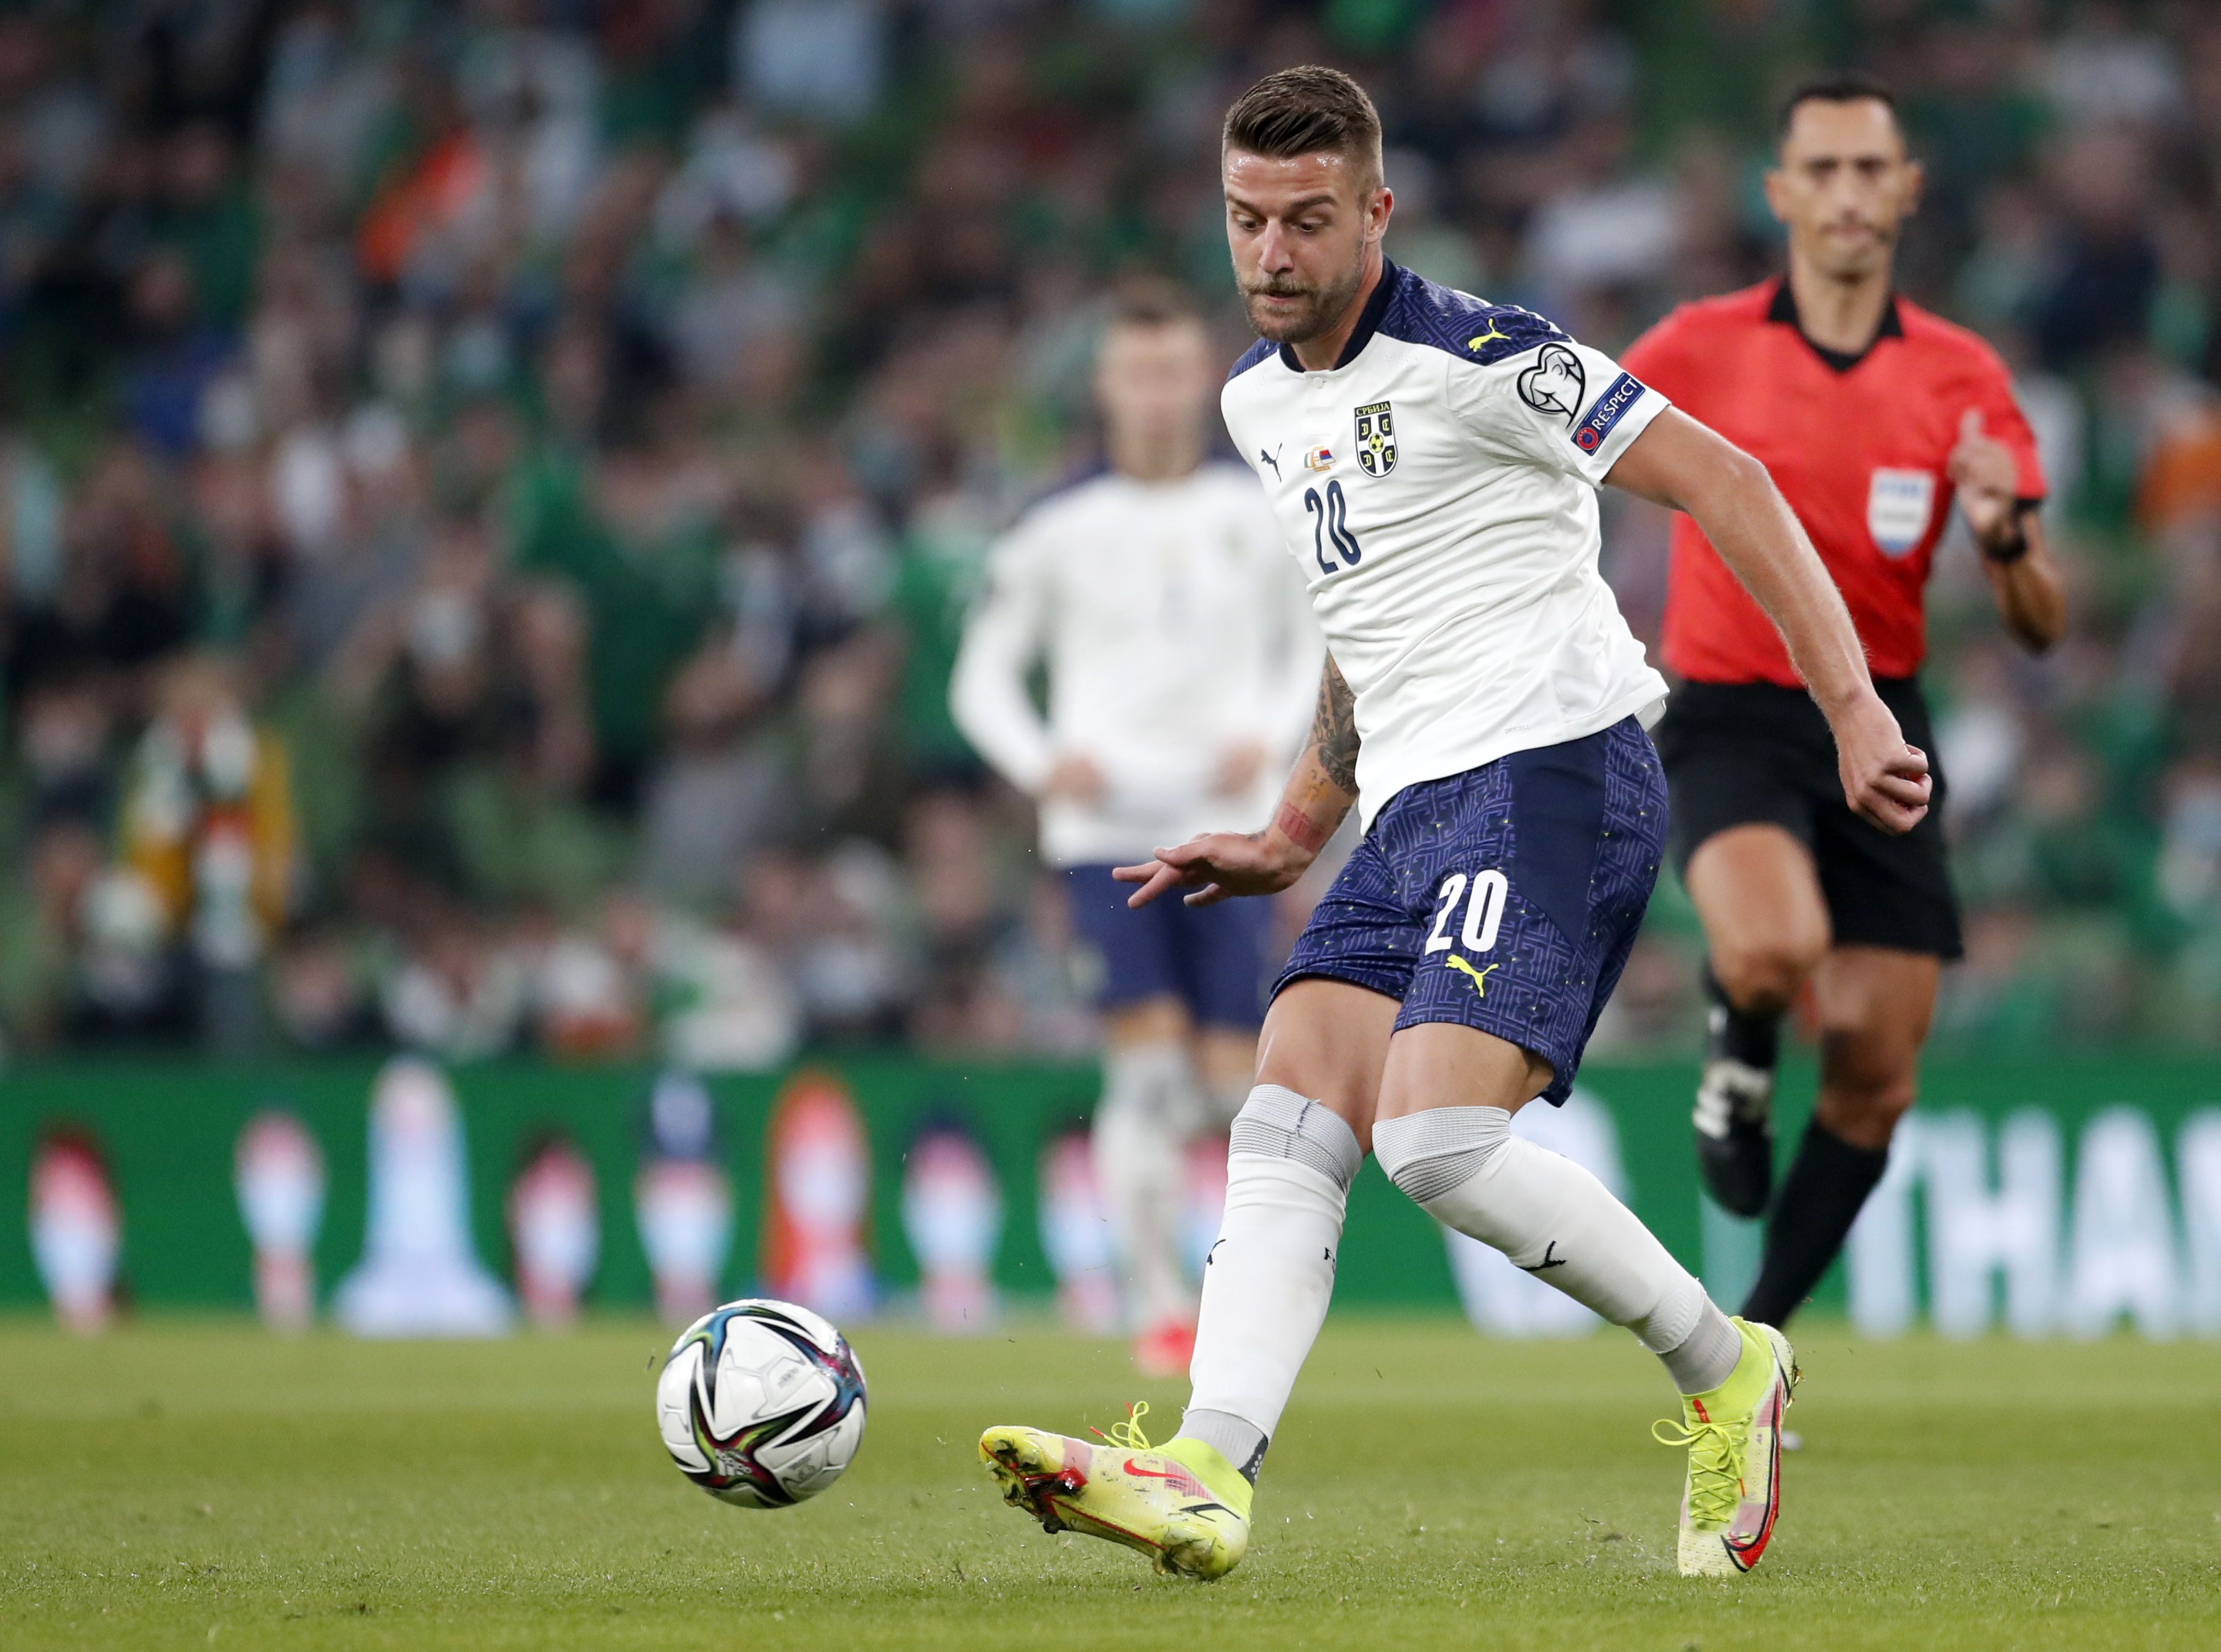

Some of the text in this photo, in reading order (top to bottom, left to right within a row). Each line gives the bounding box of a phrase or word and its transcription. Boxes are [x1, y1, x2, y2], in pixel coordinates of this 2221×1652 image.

[1356, 402, 1390, 416] СРБИЈА
[1591, 378, 1638, 431] RESPECT
[1304, 480, 1361, 575] 20
[1425, 870, 1508, 956] 20
